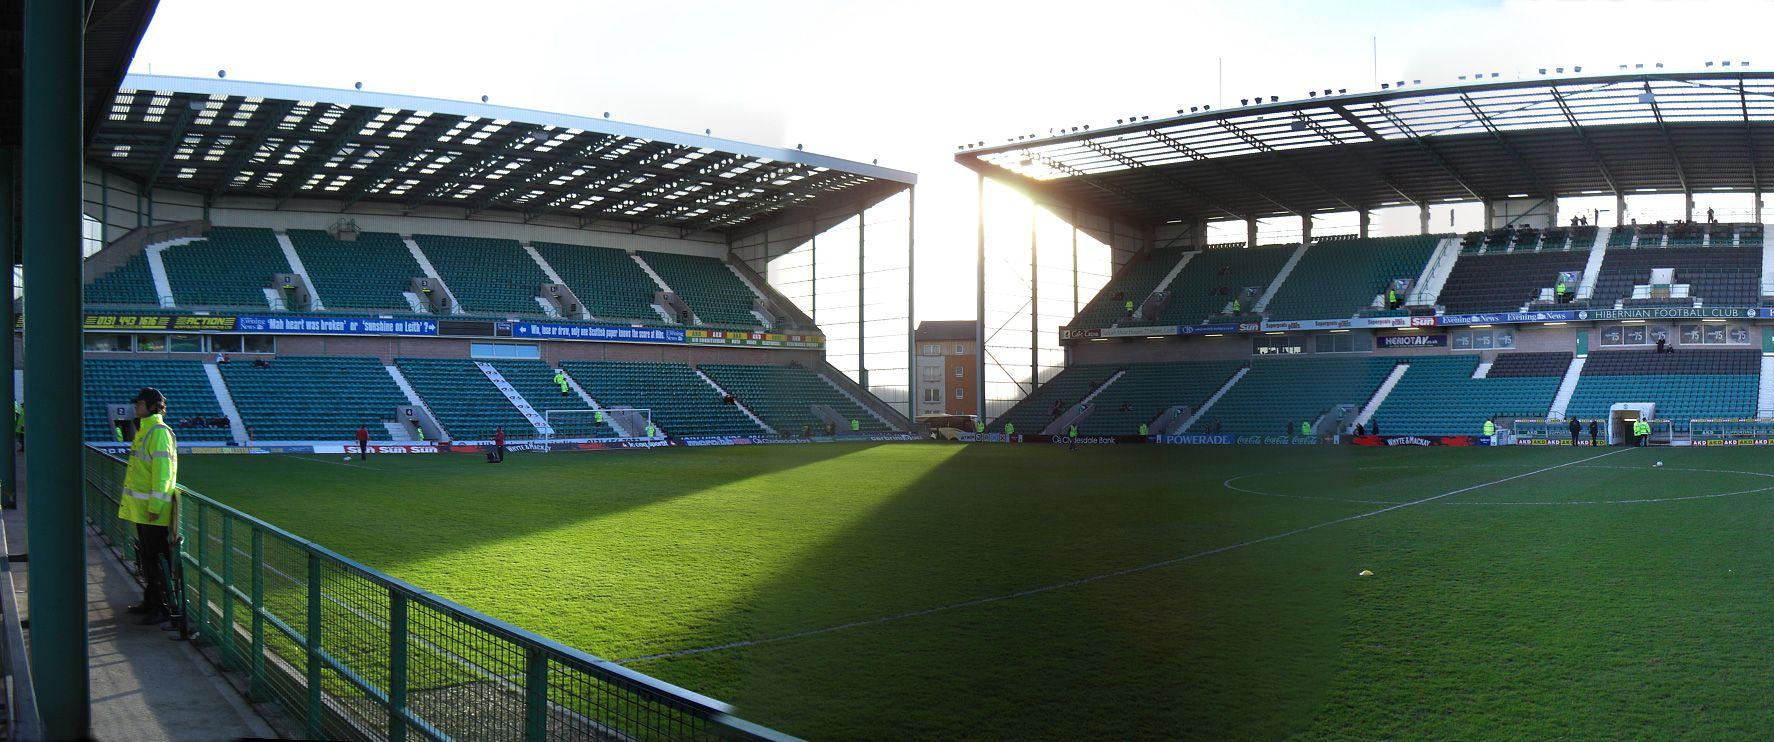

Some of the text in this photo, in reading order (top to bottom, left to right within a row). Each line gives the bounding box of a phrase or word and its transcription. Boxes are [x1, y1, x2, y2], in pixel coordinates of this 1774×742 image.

[1507, 312, 1566, 322] Evening News
[1595, 309, 1738, 319] HIBERNIAN FOOTBALL CLUB
[119, 317, 135, 325] 443
[187, 317, 225, 326] ACTION
[1411, 317, 1435, 326] Sun
[1442, 314, 1499, 326] Evening News
[286, 318, 304, 331] heart
[305, 320, 319, 331] was
[350, 322, 358, 331] or
[395, 323, 404, 333] on
[1239, 323, 1259, 332] Sun
[1167, 435, 1231, 445] POWERADE
